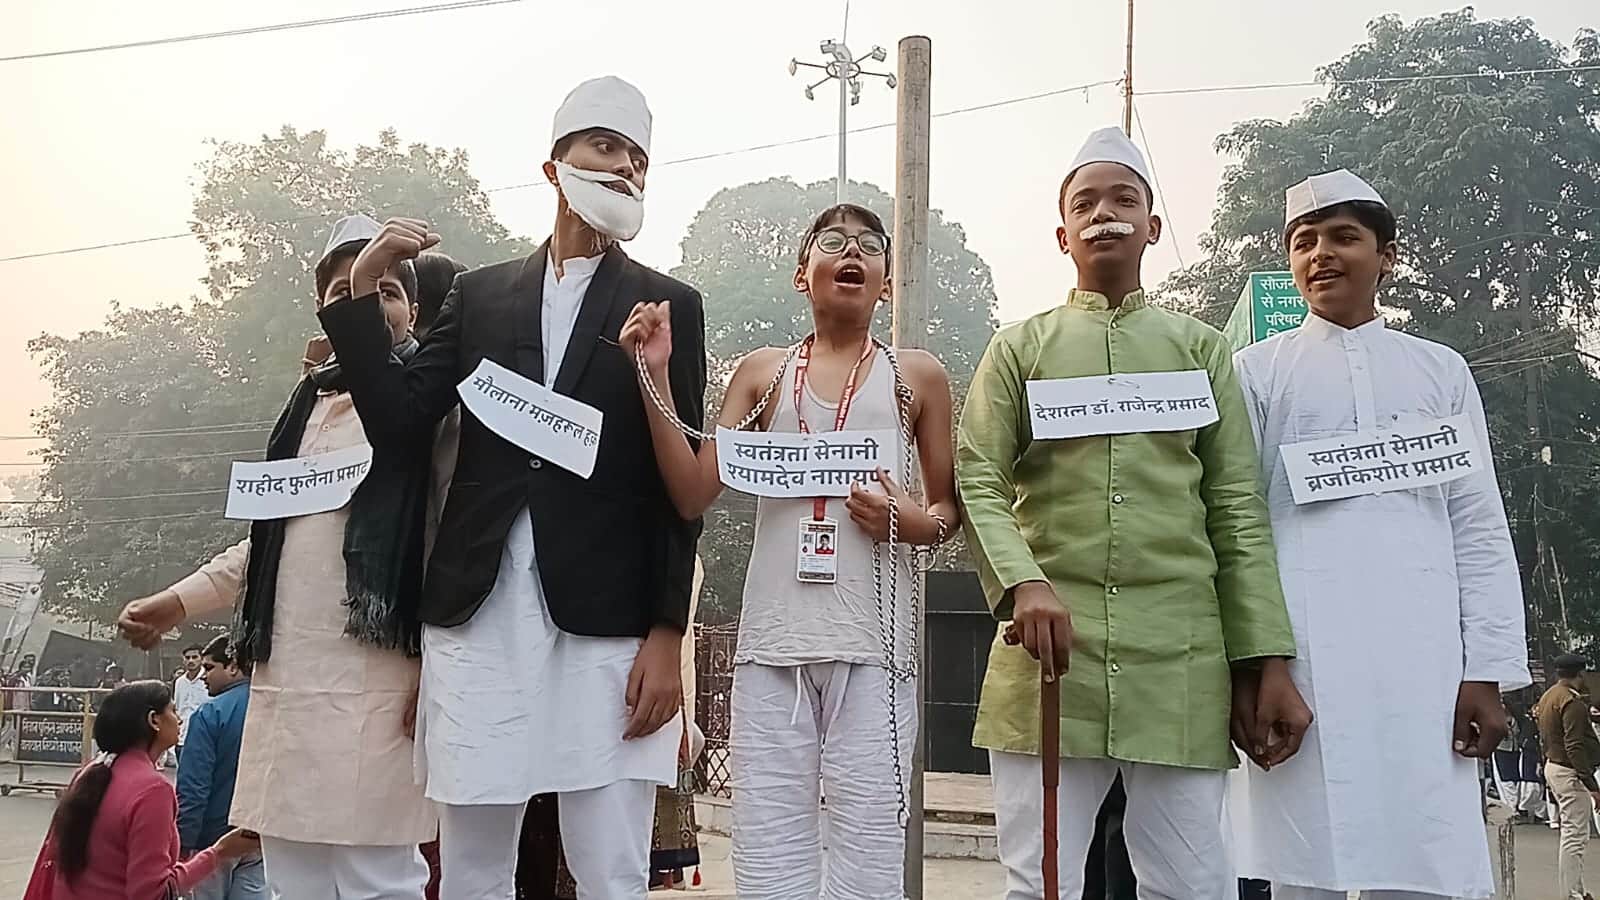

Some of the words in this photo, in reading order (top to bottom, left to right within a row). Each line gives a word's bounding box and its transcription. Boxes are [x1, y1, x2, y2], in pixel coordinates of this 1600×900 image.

[1260, 293, 1274, 308] से
[1277, 296, 1304, 308] नगर
[473, 376, 529, 412] मौलाना
[1035, 404, 1087, 421] देशरत्न
[1090, 399, 1115, 415] डॉ.
[1119, 396, 1165, 414] राजेन्द्र
[1167, 397, 1210, 412] प्रसाद
[734, 440, 809, 462] स्वतंत्रता
[814, 438, 879, 460] सेनानी
[1308, 443, 1386, 466] स्वतंत्रता
[1389, 425, 1458, 455] सेनानी
[726, 462, 806, 488] श्यामदेव
[1412, 451, 1472, 477] प्रसाद
[236, 473, 286, 496] शहीद
[289, 469, 335, 495] फुलेना
